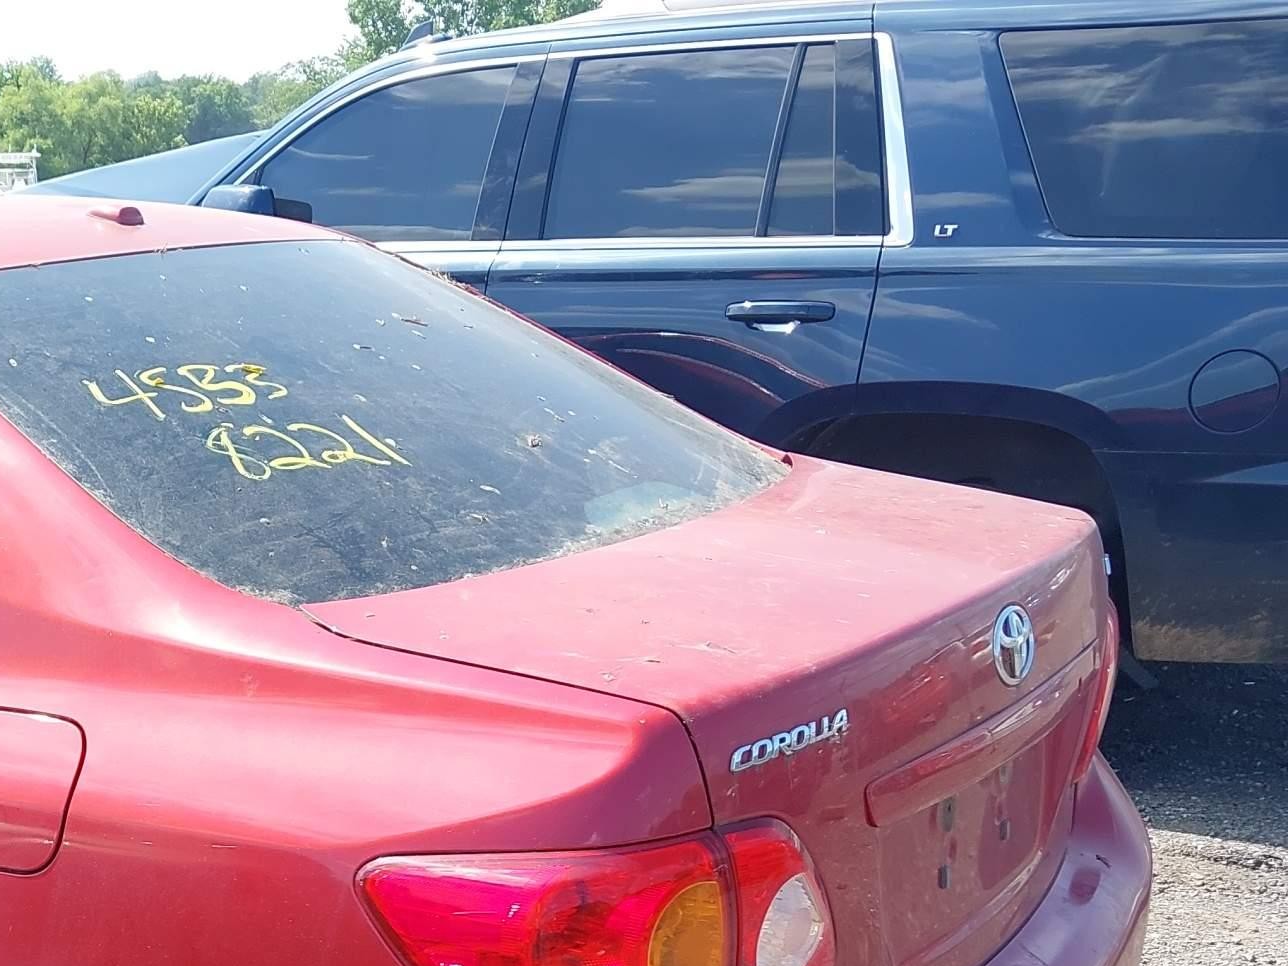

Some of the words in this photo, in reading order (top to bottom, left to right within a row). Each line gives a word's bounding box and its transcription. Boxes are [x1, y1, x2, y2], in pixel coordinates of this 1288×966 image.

[933, 224, 959, 237] LT
[206, 414, 413, 481] 8221
[729, 707, 850, 773] COROLLA
